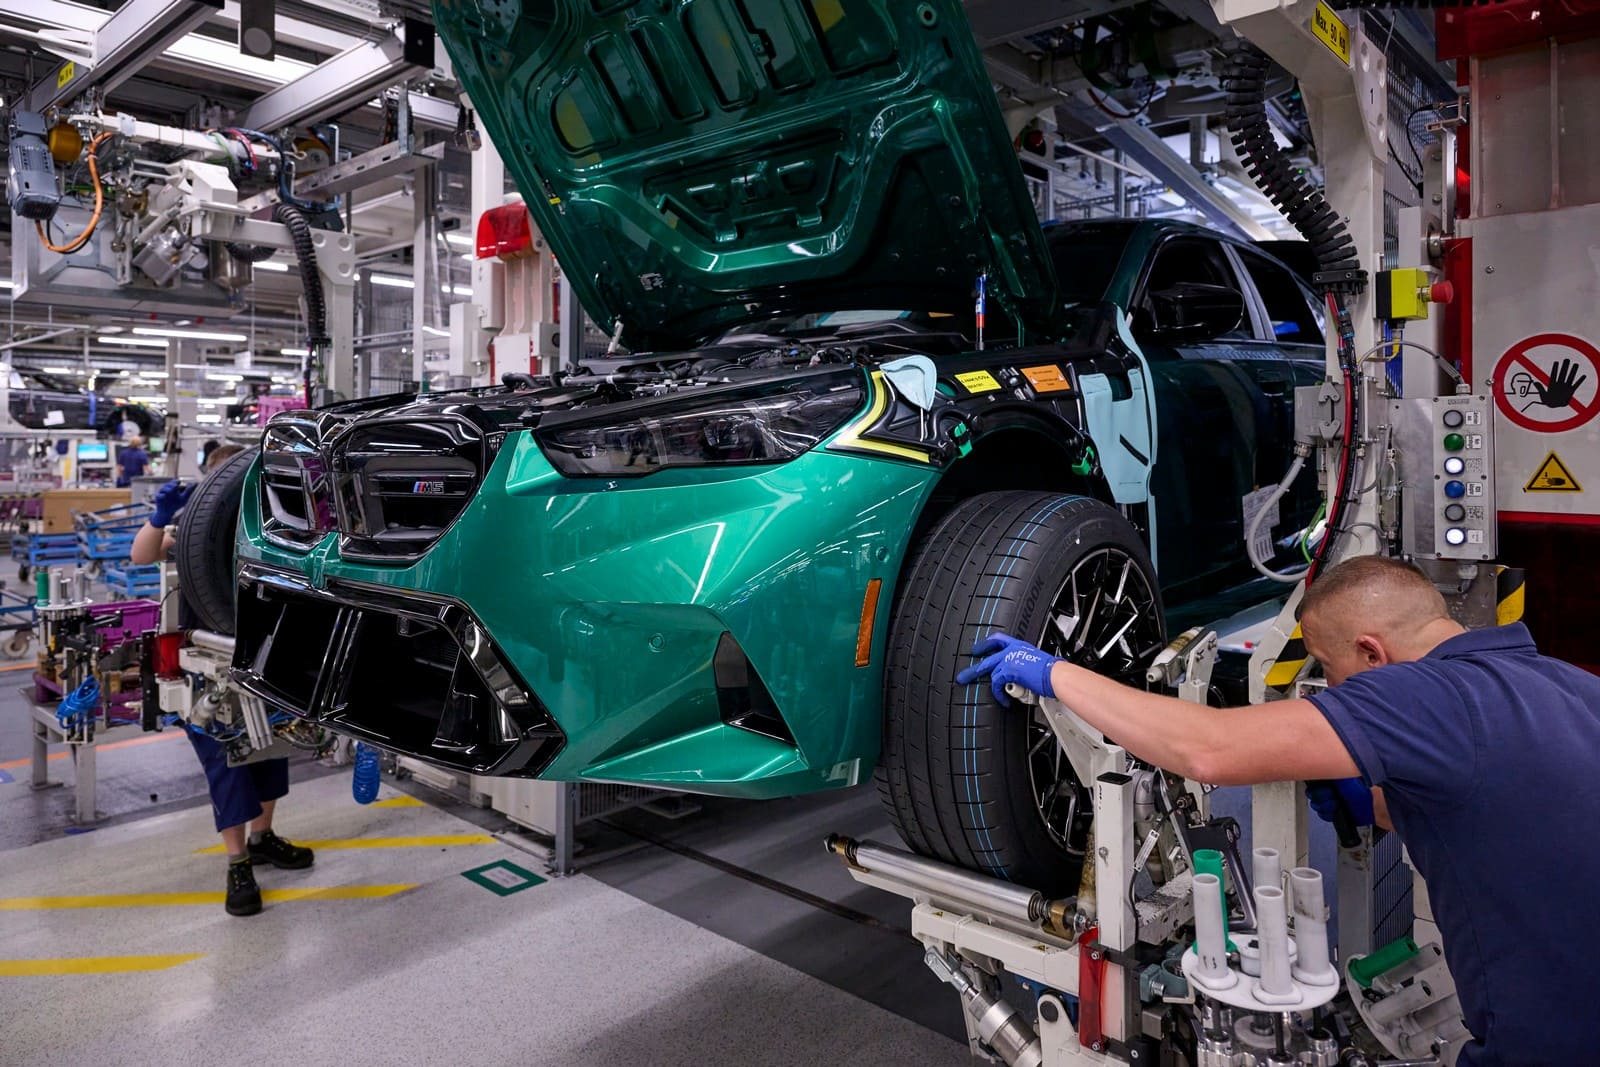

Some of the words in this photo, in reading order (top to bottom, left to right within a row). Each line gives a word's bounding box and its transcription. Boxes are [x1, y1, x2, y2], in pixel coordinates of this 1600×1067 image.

[1315, 7, 1329, 34] Max.
[1330, 22, 1337, 43] 50
[1339, 31, 1346, 54] kg
[1370, 87, 1374, 105] 1
